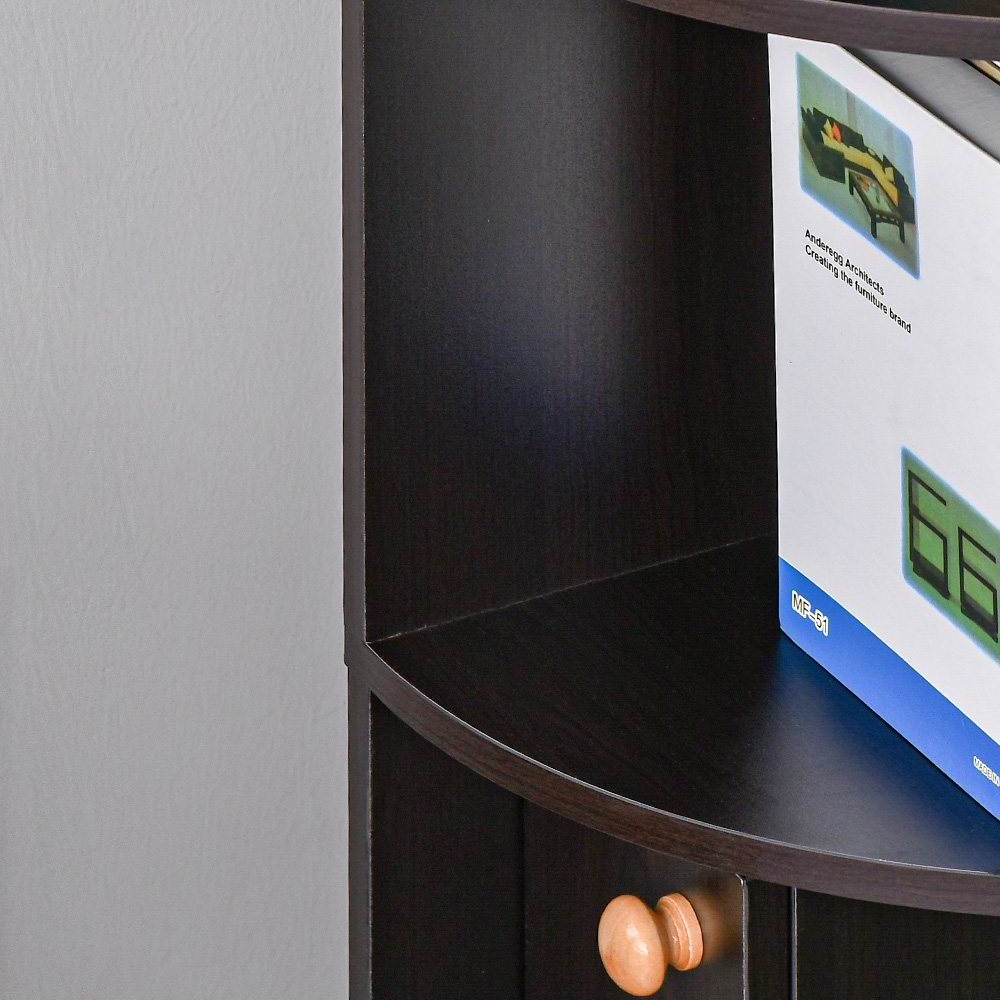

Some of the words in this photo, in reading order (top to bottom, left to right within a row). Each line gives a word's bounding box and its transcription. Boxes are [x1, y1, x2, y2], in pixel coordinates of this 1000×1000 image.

[805, 229, 843, 266] Anderegg
[845, 259, 884, 296] Architects
[805, 245, 839, 278] Creating
[840, 270, 853, 287] the
[855, 281, 888, 314] furniture
[889, 307, 912, 334] brand
[792, 591, 828, 636] MF-51
